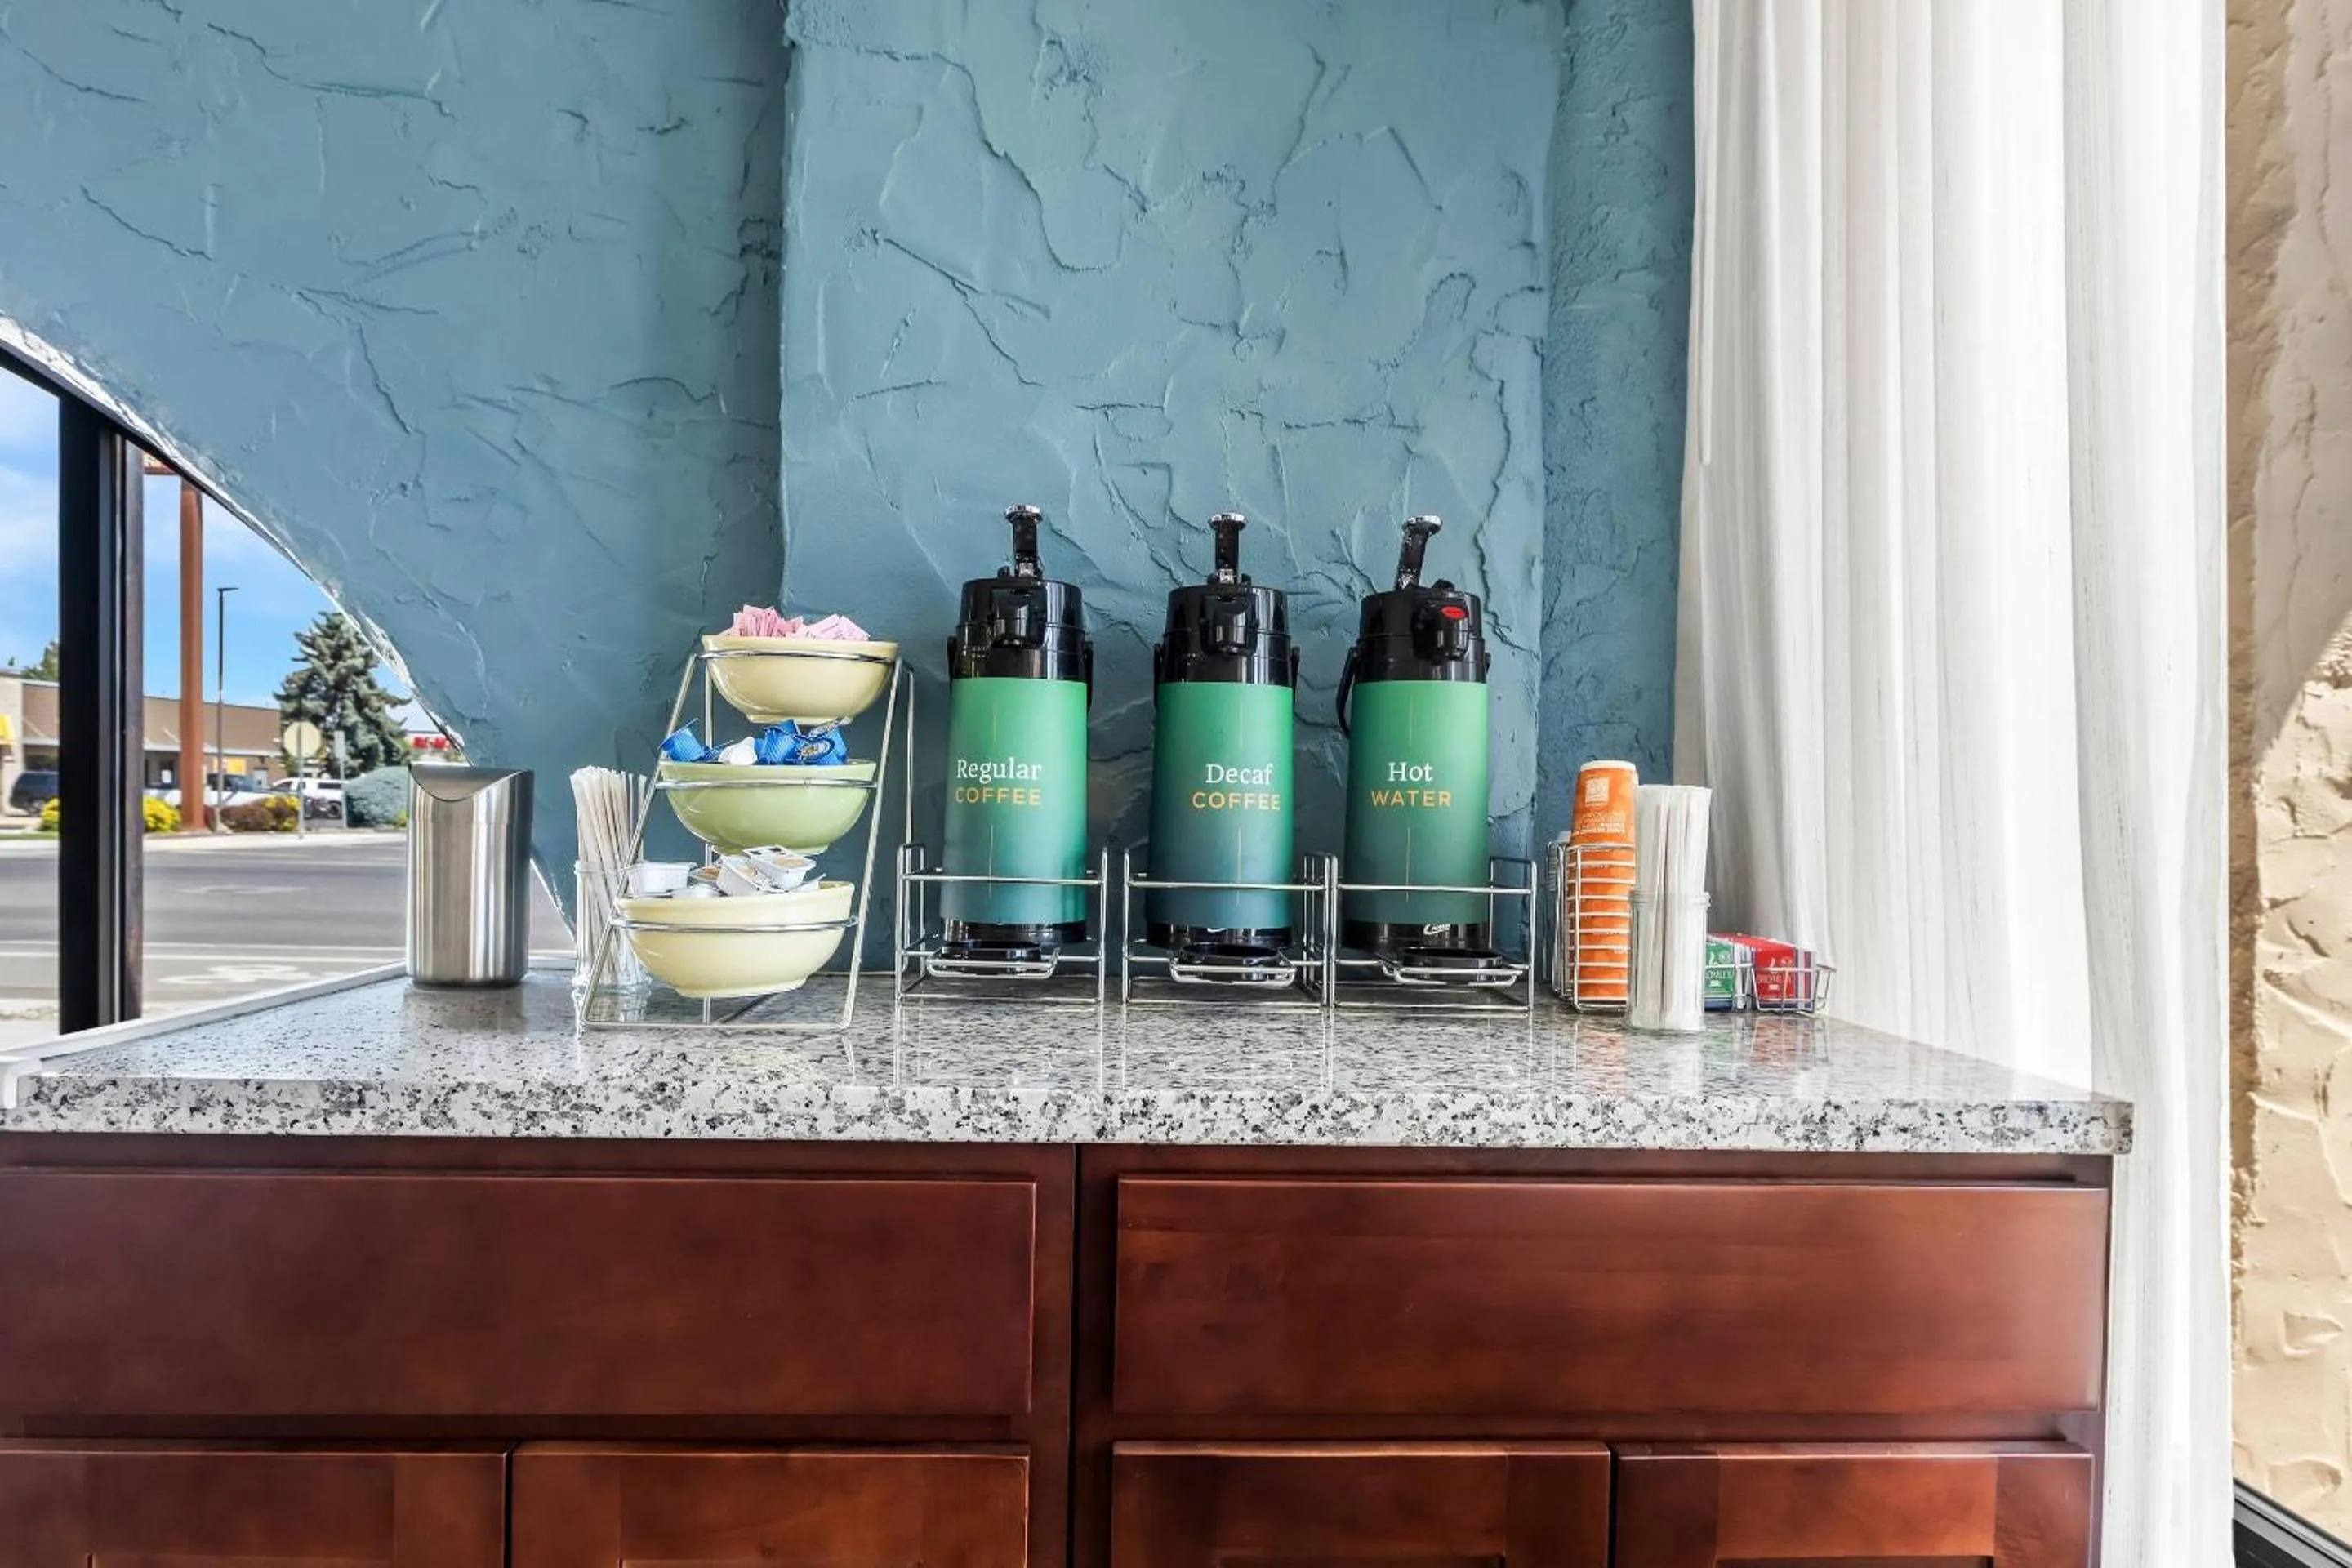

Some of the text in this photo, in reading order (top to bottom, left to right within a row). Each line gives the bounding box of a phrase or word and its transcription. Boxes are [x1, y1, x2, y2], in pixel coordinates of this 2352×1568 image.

[956, 757, 1042, 784] Regular
[1205, 763, 1274, 785] Decaf
[1388, 761, 1434, 782] Hot
[956, 786, 1042, 806] COFFEE
[1192, 791, 1281, 810] COFFEE
[1371, 790, 1451, 807] WATER
